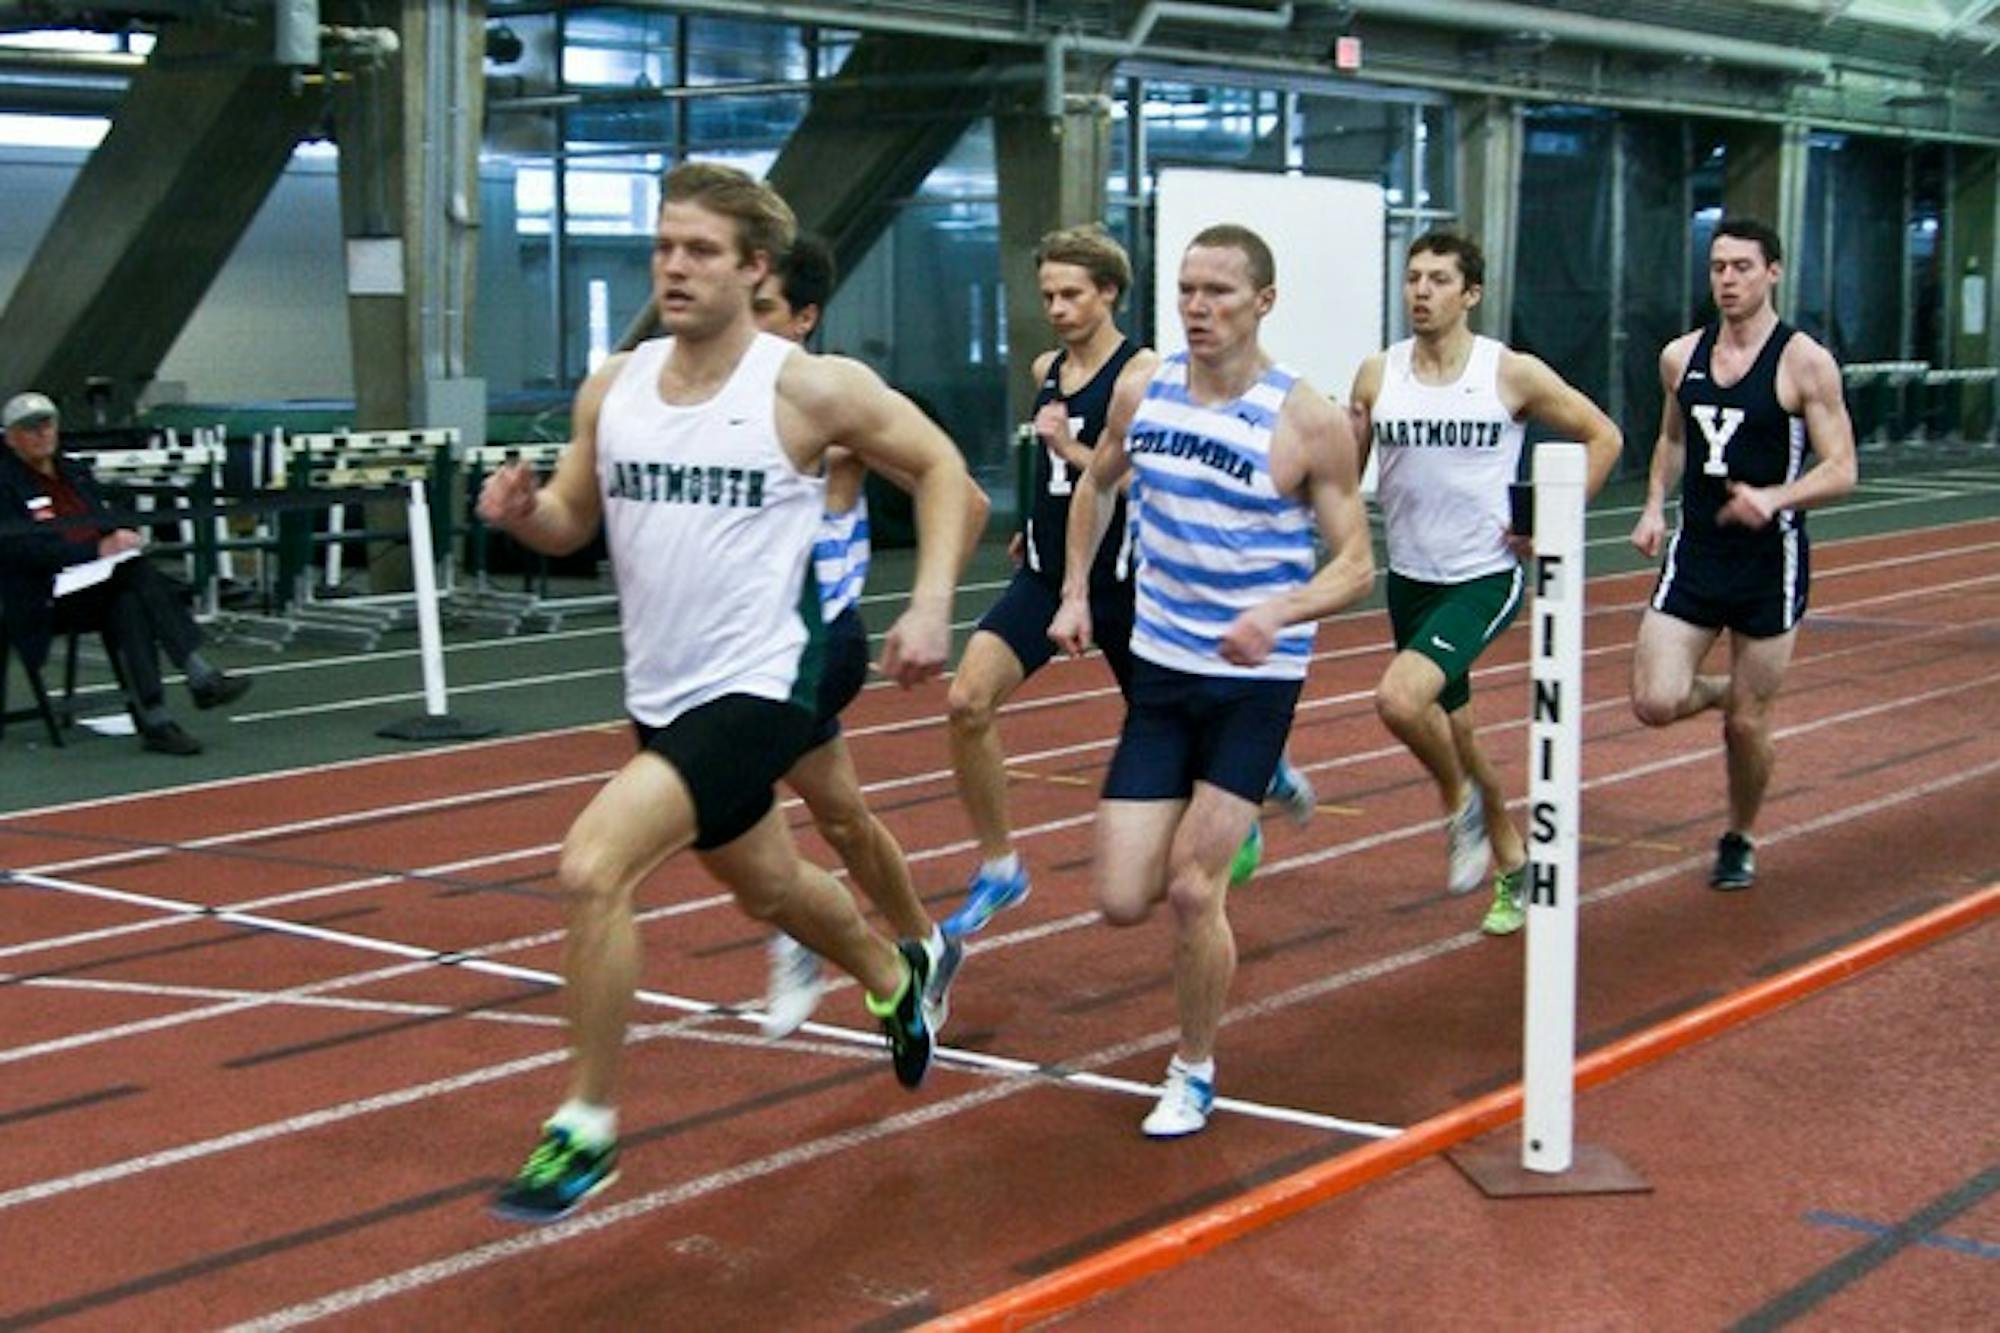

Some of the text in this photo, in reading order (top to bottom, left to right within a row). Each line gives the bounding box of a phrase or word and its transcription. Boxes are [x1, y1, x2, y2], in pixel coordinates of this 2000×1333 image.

[1129, 428, 1255, 486] COLUMBIA
[1691, 404, 1745, 475] Y
[1531, 556, 1561, 907] FINISH
